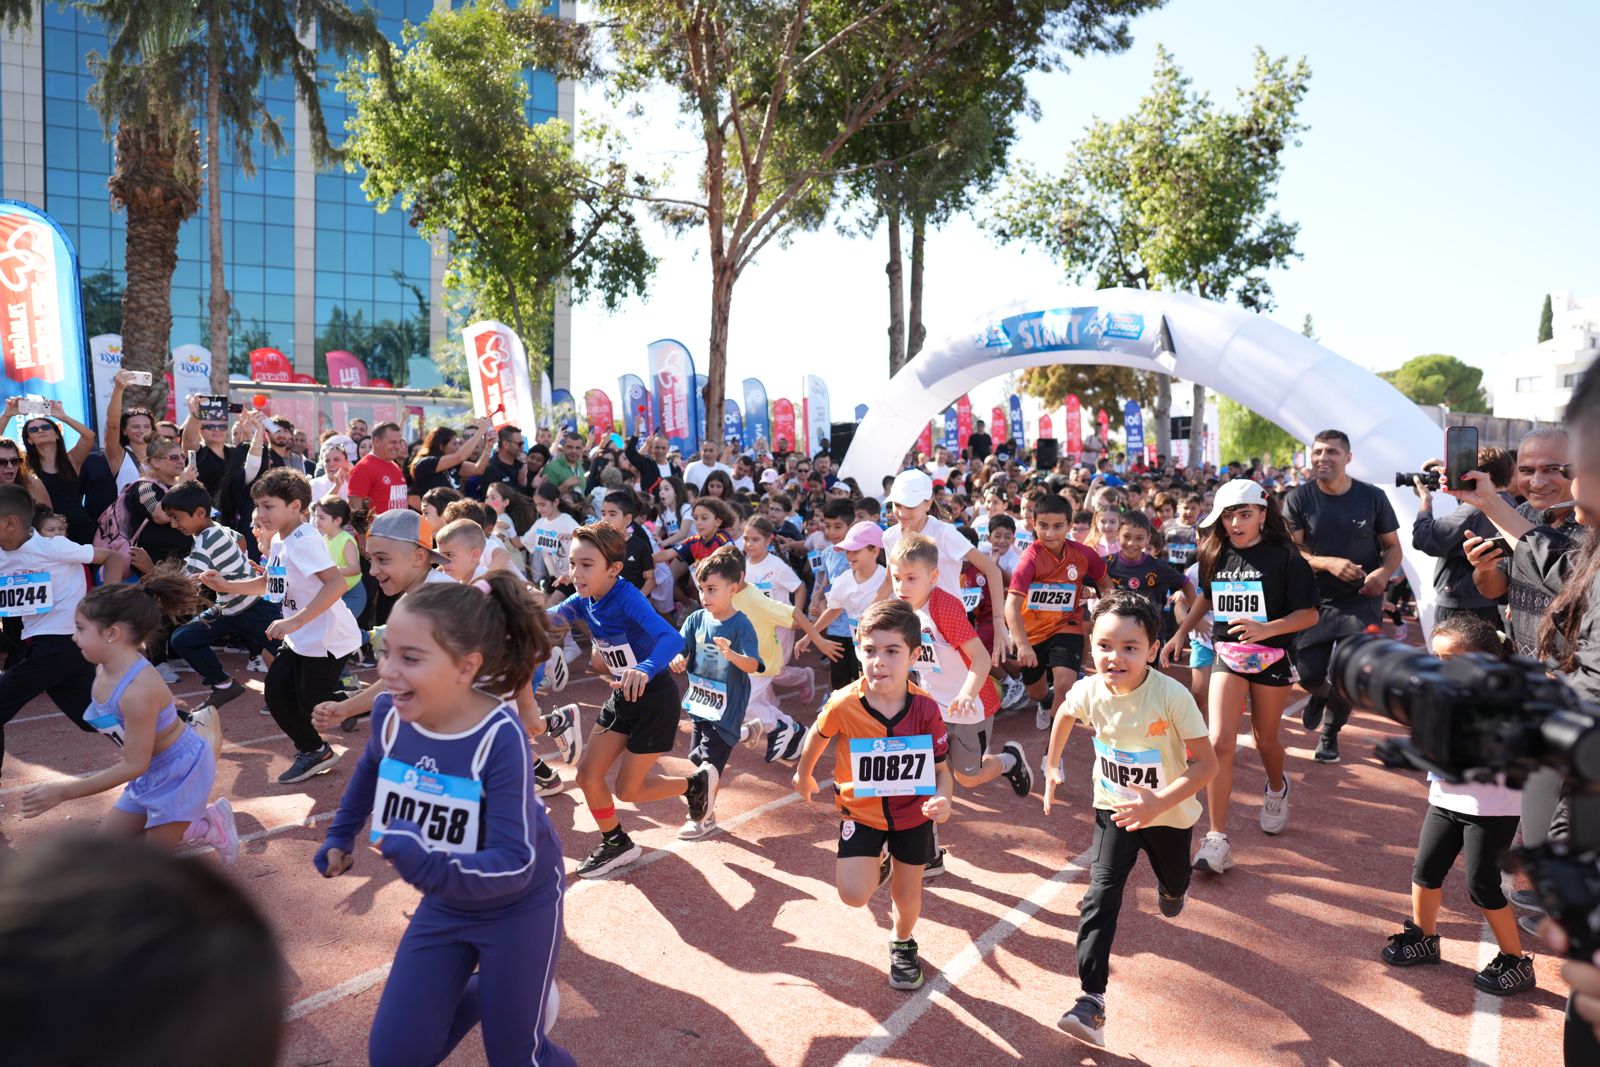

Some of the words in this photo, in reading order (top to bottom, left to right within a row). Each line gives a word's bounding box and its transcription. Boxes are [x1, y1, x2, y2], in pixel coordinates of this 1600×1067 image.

[1018, 315, 1084, 349] START
[1217, 567, 1264, 579] SKECHERS
[0, 586, 47, 607] 00244
[1031, 591, 1072, 605] 00253
[1218, 595, 1259, 612] 00519
[689, 686, 724, 710] 00503
[859, 753, 926, 782] 00827
[1101, 756, 1159, 789] 00624
[382, 791, 469, 845] 00758
